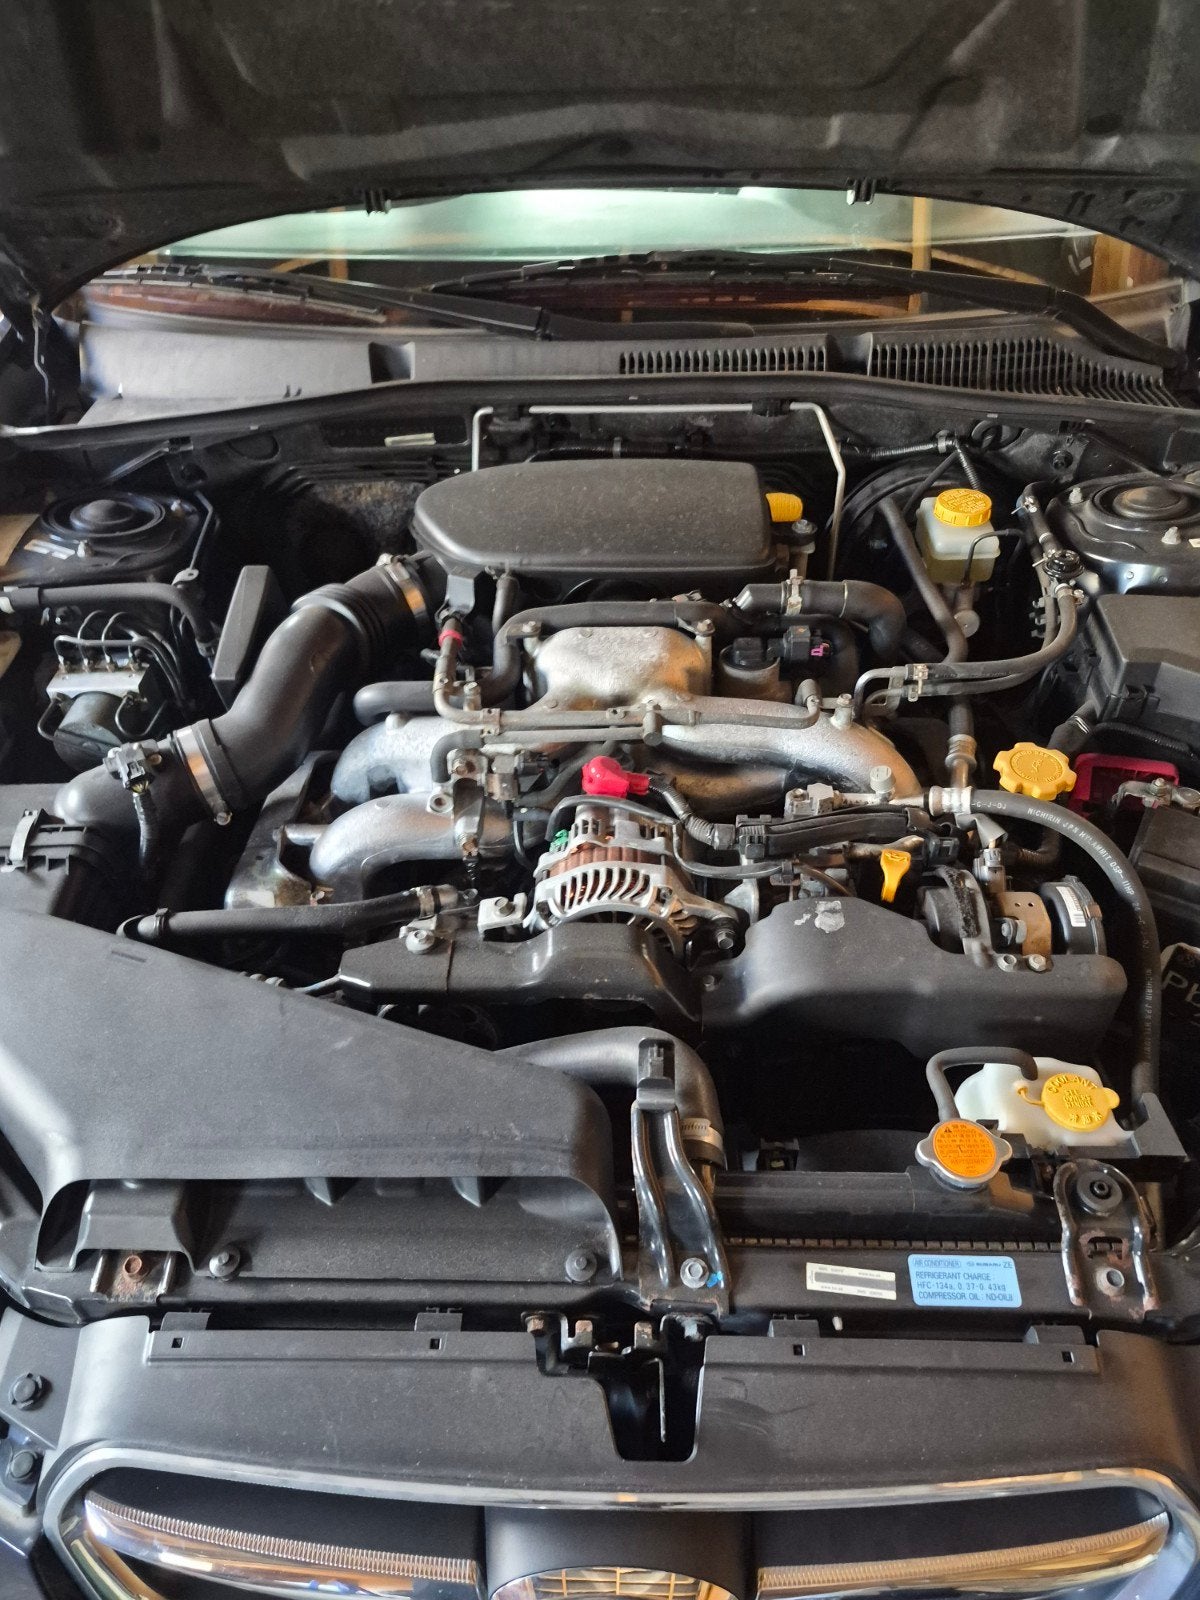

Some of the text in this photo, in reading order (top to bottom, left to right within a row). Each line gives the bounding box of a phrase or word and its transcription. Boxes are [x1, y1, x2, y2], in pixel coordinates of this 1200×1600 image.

[1027, 807, 1062, 824] NICHIRIN
[915, 1271, 961, 1280] REFRIGERANT
[918, 1291, 966, 1300] COMPRESSOR
